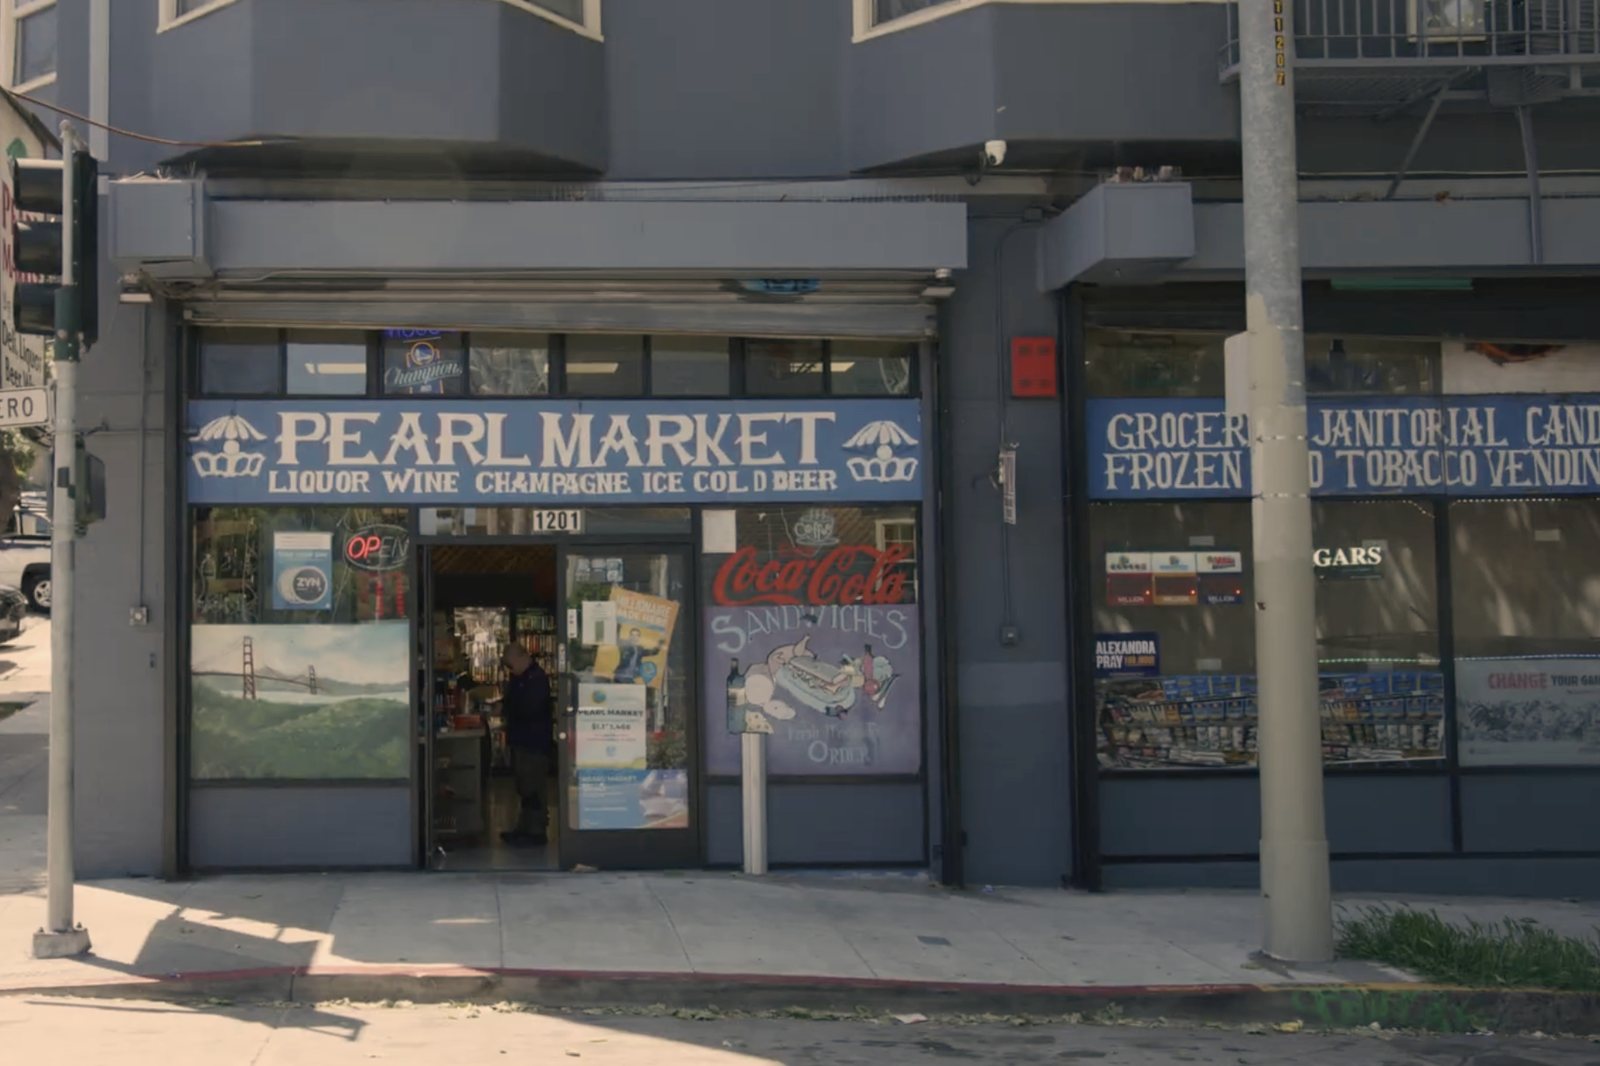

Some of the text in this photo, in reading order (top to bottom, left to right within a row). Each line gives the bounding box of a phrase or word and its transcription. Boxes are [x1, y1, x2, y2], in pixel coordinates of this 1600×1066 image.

[274, 411, 836, 467] PEARL MARKET
[1108, 405, 1600, 450] GROCER JANITORIAL CAND
[1106, 451, 1242, 489] FROZEN
[1335, 449, 1479, 488] TOBACCO
[1483, 448, 1600, 487] VENDIN
[268, 469, 370, 495] LIQUOR
[382, 468, 460, 494] WINE
[475, 471, 631, 495] CHAMPAGNE
[643, 470, 685, 494] ICE
[772, 469, 838, 492] BEER
[535, 511, 581, 531] 1201
[348, 535, 410, 559] OPEN
[1312, 541, 1382, 567] GARS
[296, 576, 321, 588] ZYN
[711, 604, 908, 654] SANDWICHES
[1096, 640, 1156, 655] ALEXANDRA
[1096, 655, 1124, 670] PRAY
[1488, 672, 1548, 690] CHANGE
[1550, 674, 1578, 687] YOUR
